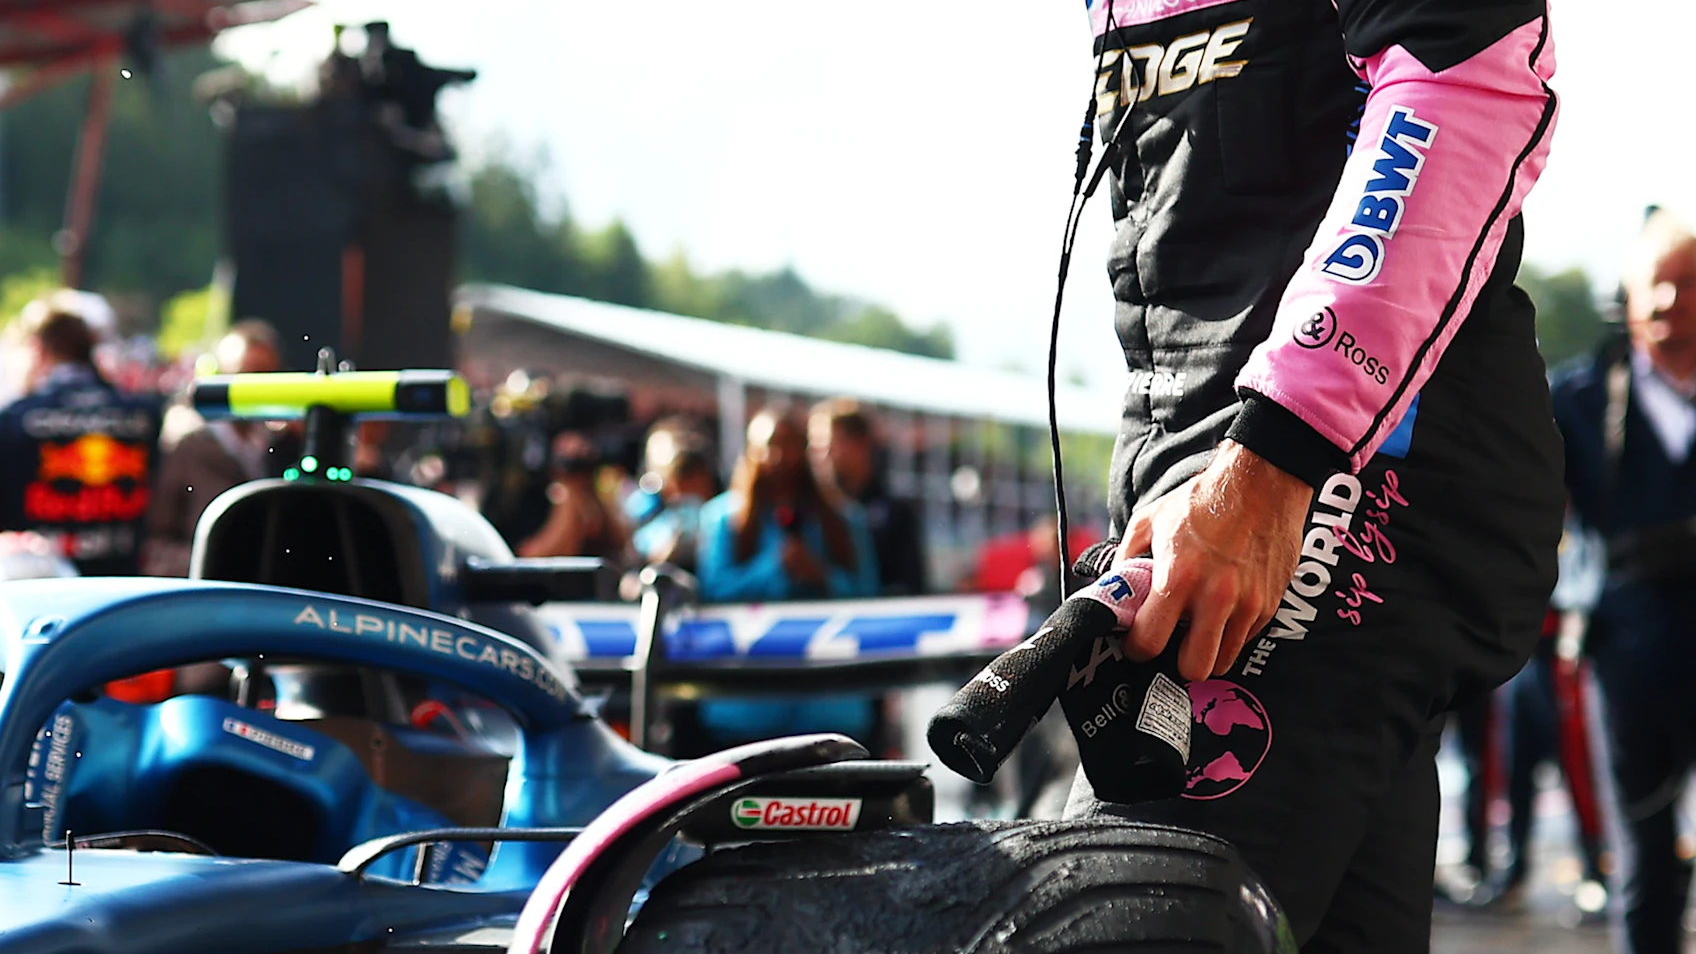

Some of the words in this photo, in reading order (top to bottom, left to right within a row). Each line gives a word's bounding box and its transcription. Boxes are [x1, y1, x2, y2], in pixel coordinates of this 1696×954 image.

[1350, 104, 1439, 241] BWT
[1333, 331, 1390, 385] Ross
[1241, 637, 1277, 676] THE
[1267, 472, 1363, 641] WORLD
[1335, 572, 1385, 626] sip
[1081, 703, 1117, 739] Bell
[763, 800, 853, 827] Castrol
